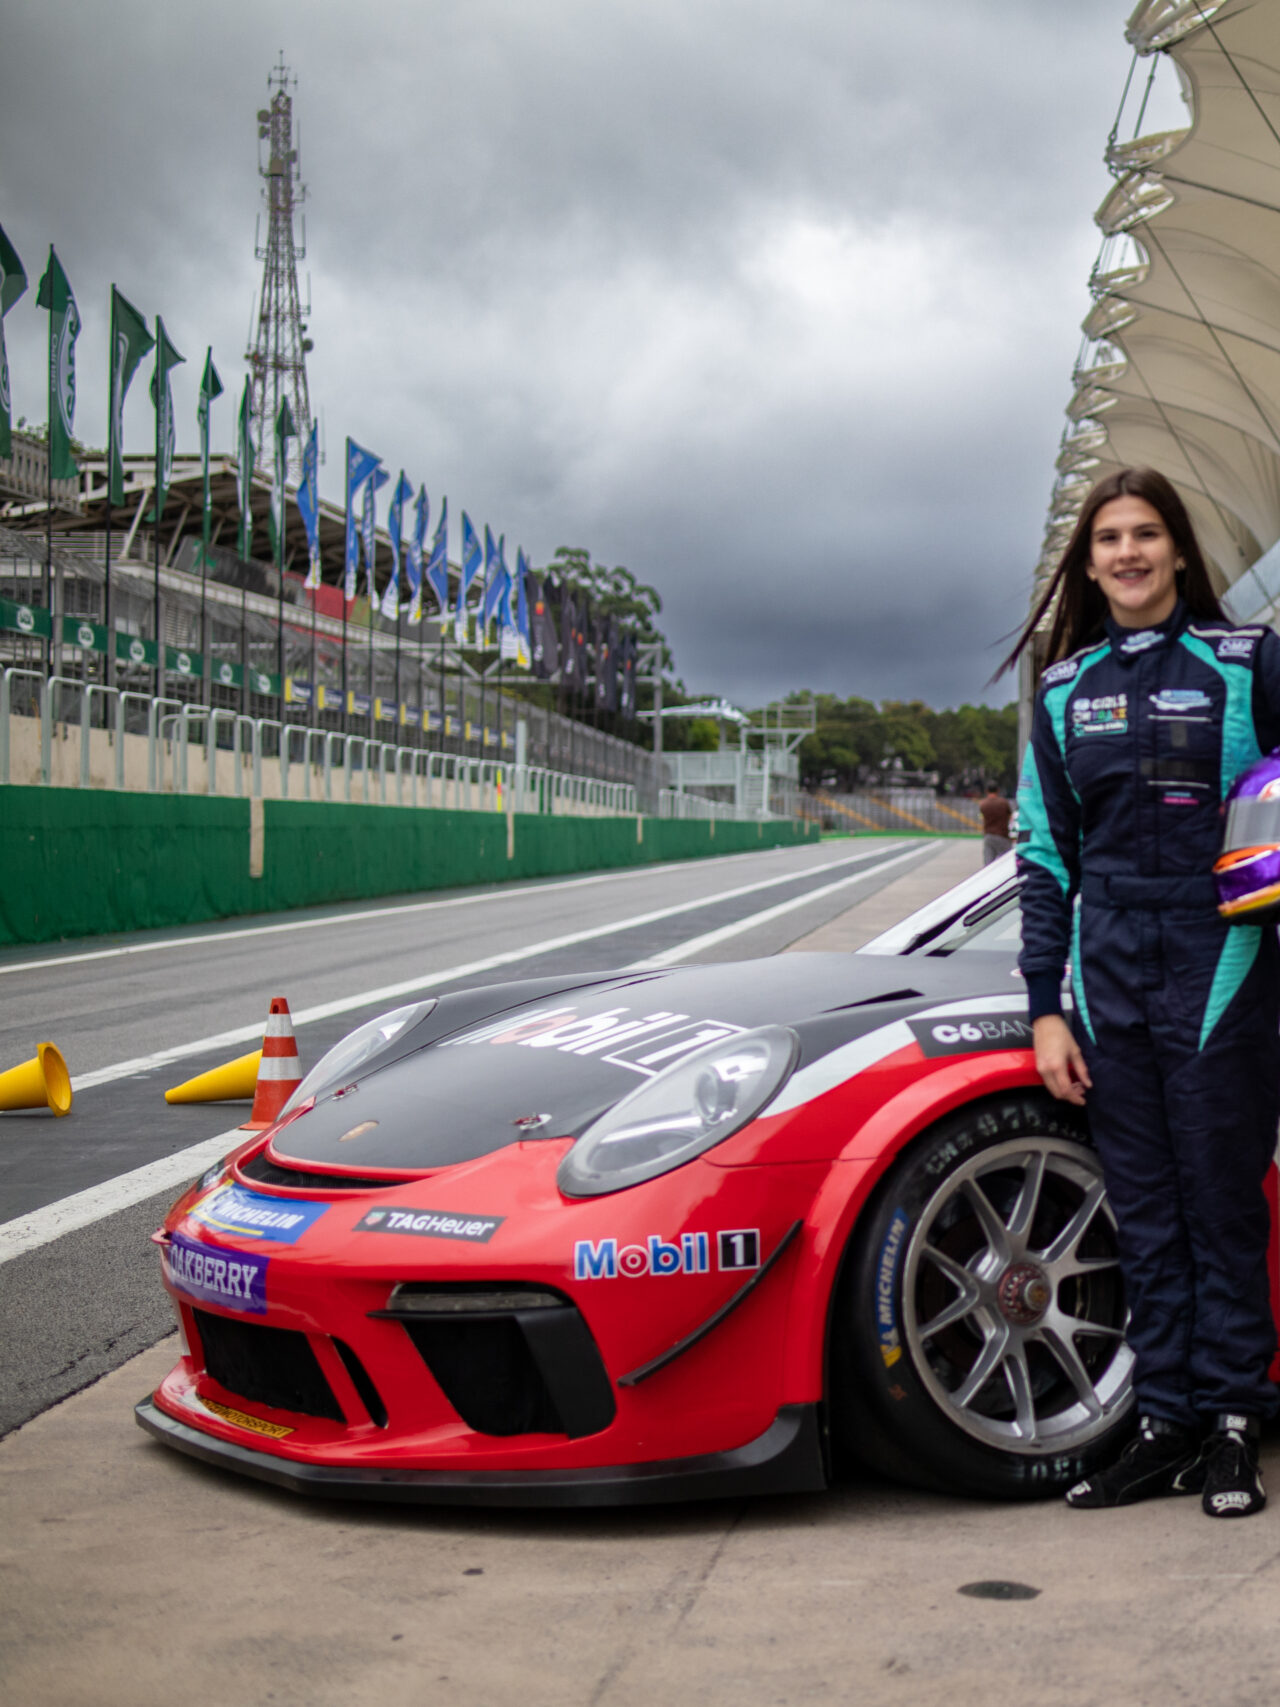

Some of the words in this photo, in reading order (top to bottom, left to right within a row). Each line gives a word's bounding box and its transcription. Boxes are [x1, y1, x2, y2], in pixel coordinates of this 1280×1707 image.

[437, 1007, 690, 1055] Mobil
[218, 1199, 305, 1229] MICHELIN
[170, 1244, 259, 1299] OAKBERRY
[575, 1232, 710, 1281] Mobil
[878, 1218, 907, 1330] MICHELIN
[1211, 1491, 1252, 1509] OMP
